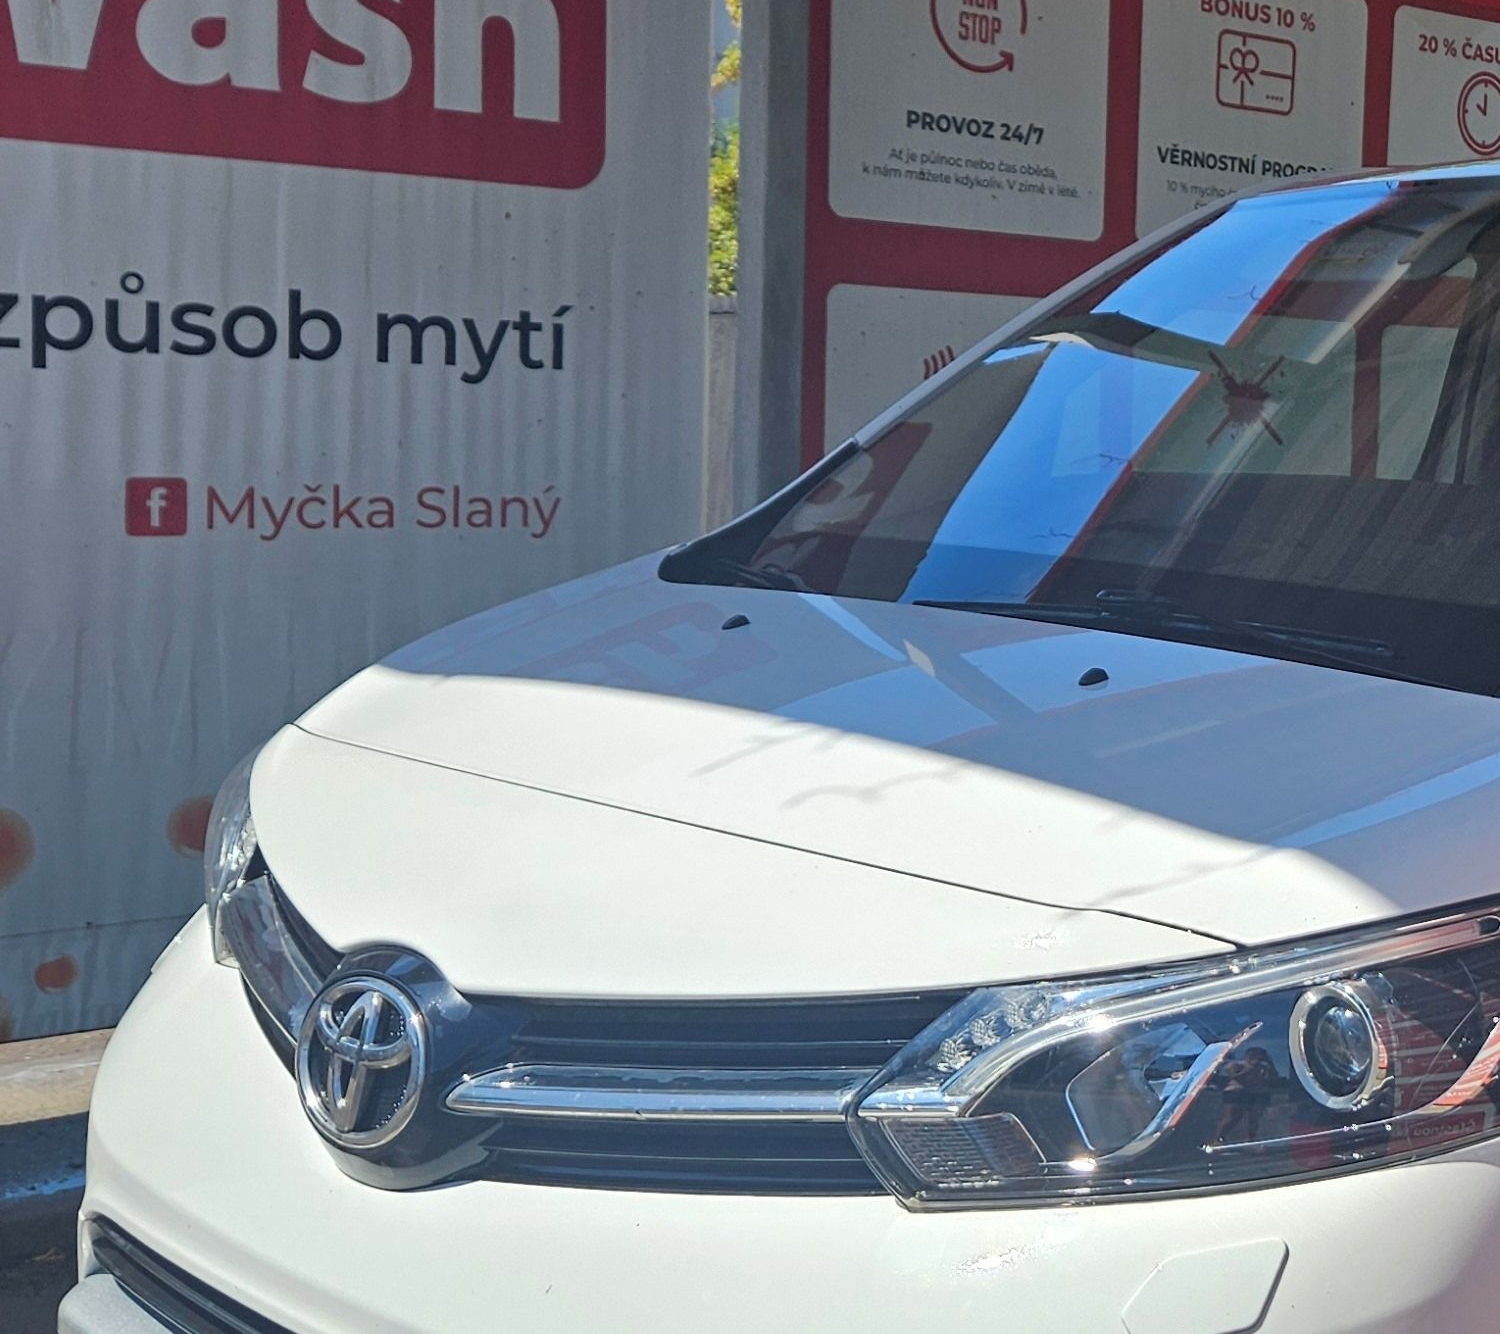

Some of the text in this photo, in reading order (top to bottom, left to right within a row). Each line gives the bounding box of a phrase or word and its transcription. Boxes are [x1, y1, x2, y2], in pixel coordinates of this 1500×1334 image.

[958, 10, 1002, 45] STOP
[1276, 8, 1295, 28] 10
[1300, 13, 1316, 32] %
[1418, 34, 1438, 54] 20
[1443, 39, 1458, 58] %
[906, 110, 1044, 146] PROVOZ 24/7
[905, 148, 918, 164] je
[920, 150, 963, 168] půlnoc
[965, 158, 995, 171] nebo
[1157, 143, 1257, 175] VĚRNOSTNÍ
[862, 162, 871, 174] k
[873, 164, 902, 178] nám
[904, 168, 951, 184] můžete
[1006, 179, 1016, 190] V
[377, 305, 575, 385] mytí
[205, 483, 395, 541] Myčka
[416, 485, 561, 540] Slaný
